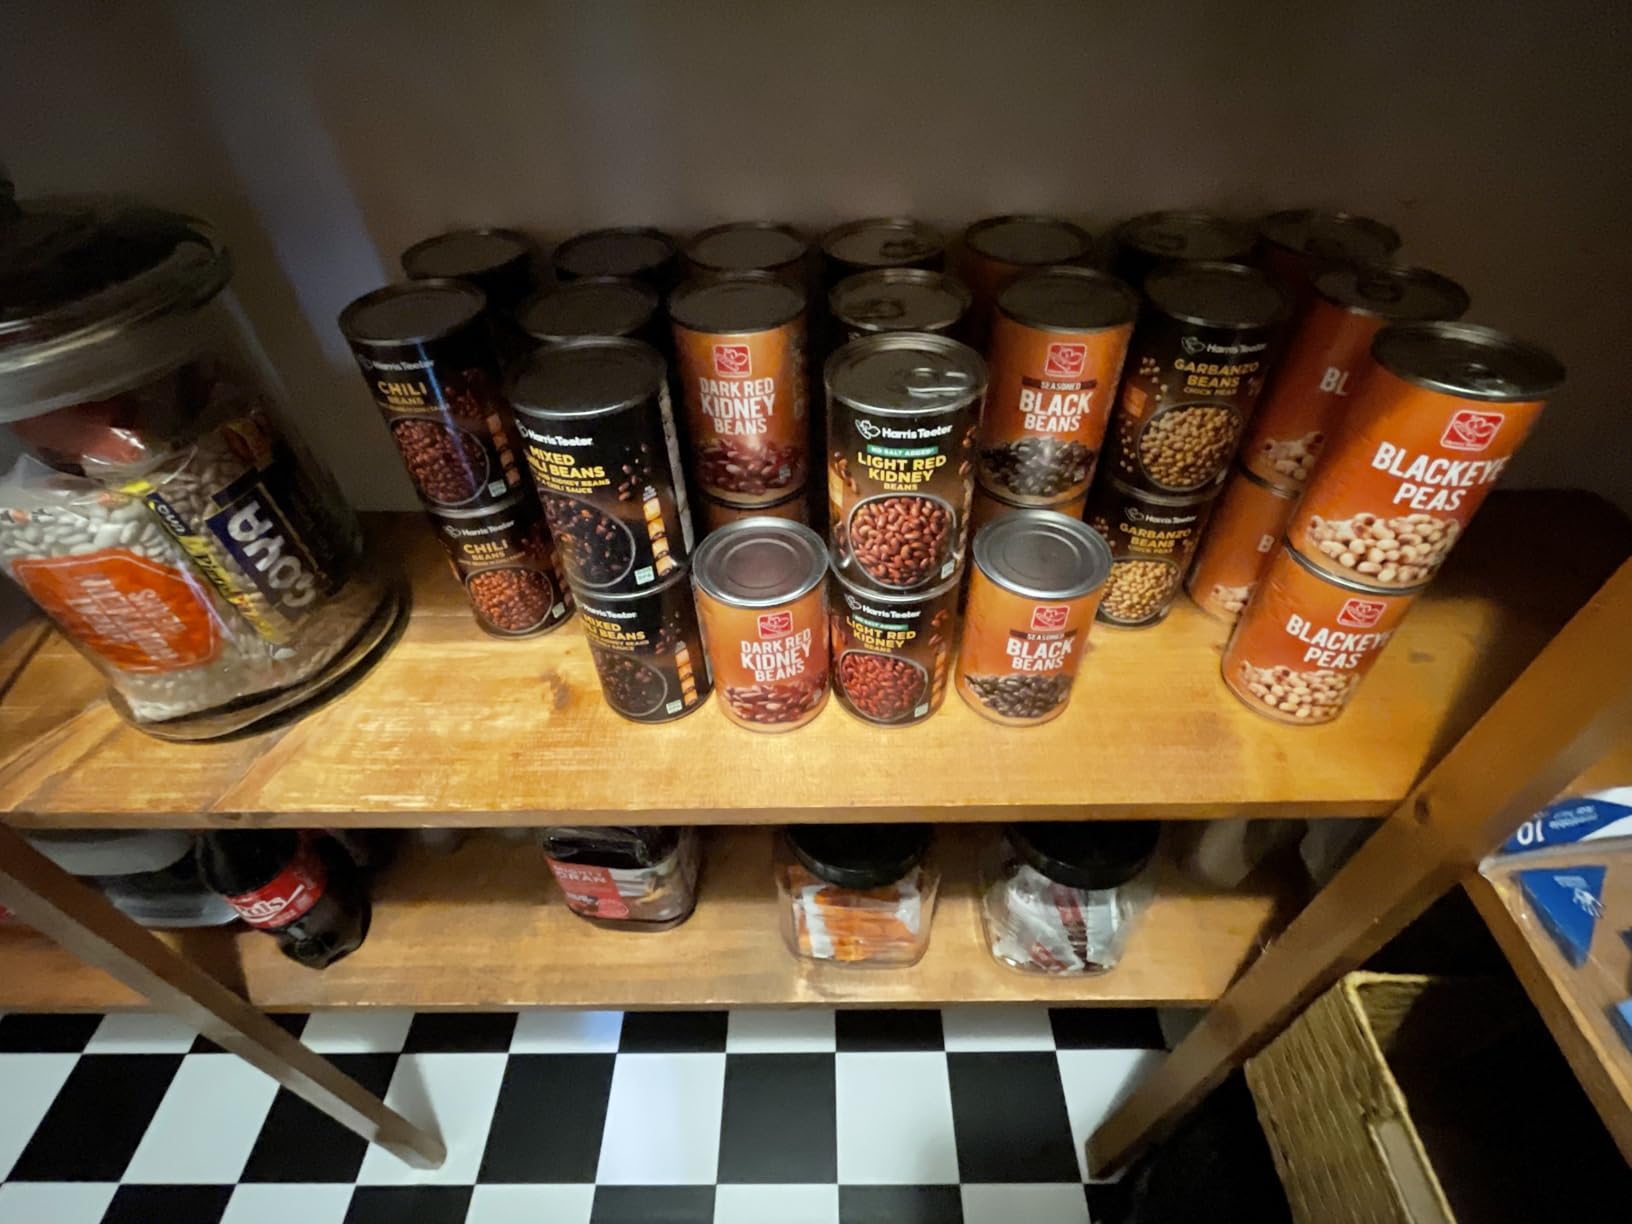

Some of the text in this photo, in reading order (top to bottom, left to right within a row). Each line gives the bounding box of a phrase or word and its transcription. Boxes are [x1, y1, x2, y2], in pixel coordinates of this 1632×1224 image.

[1174, 358, 1260, 376] GARBANZO
[377, 380, 428, 396] CHILI
[699, 377, 775, 397] DARK RED
[1040, 381, 1082, 391] SEASONED
[1187, 374, 1240, 388] BEANS
[699, 392, 776, 419] KIDNEY
[1019, 388, 1095, 416] BLACK
[713, 417, 768, 435] BEANS
[881, 424, 953, 439] Harris Teeter
[1024, 413, 1082, 432] BEANS
[529, 444, 575, 466] MIXED
[884, 447, 903, 456] SALT
[857, 451, 947, 471] LIGHT RED
[548, 463, 606, 479] BEANS
[868, 467, 934, 483] KIDNEY
[883, 482, 919, 491] BEANS
[1392, 482, 1467, 511] PEAS
[1119, 522, 1192, 539] GARBANZO
[463, 539, 509, 554] CHILI
[1130, 536, 1175, 548] BEANS
[227, 501, 316, 608] GOYA
[471, 551, 506, 561] BEANS
[862, 604, 921, 619] Harris Teeter
[598, 628, 646, 641] BEANS
[846, 615, 917, 640] LIGHT RED
[740, 627, 811, 654] DARK RED
[853, 629, 905, 648] KIDNEY
[863, 642, 892, 653] BEANS
[1006, 636, 1076, 659] BLACK
[740, 639, 812, 671] KIDNEY
[1011, 656, 1065, 671] BEANS
[1303, 646, 1362, 669] PEAS
[755, 658, 805, 682] BEANS
